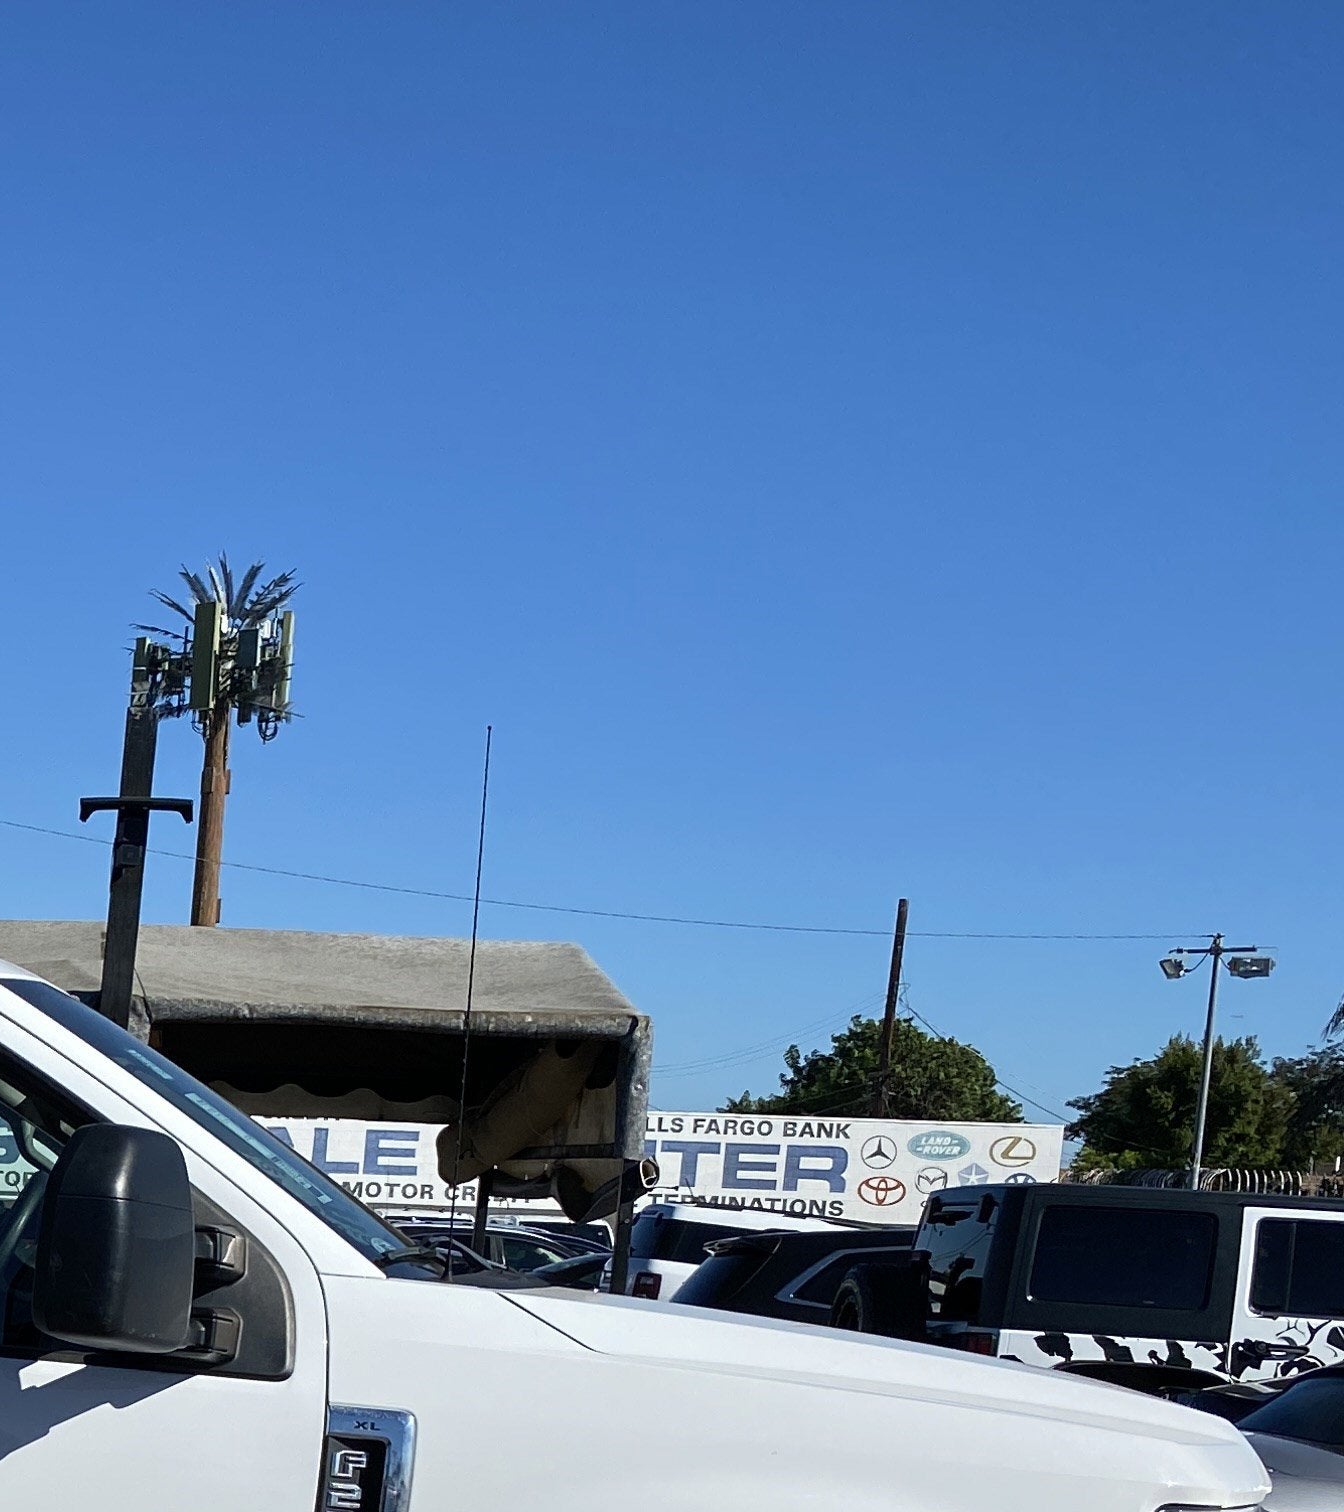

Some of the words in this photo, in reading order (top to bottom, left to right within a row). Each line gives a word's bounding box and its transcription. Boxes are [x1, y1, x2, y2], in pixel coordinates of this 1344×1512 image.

[692, 1118, 773, 1137] FARGO
[783, 1122, 851, 1139] BANK
[354, 1420, 381, 1431] XL
